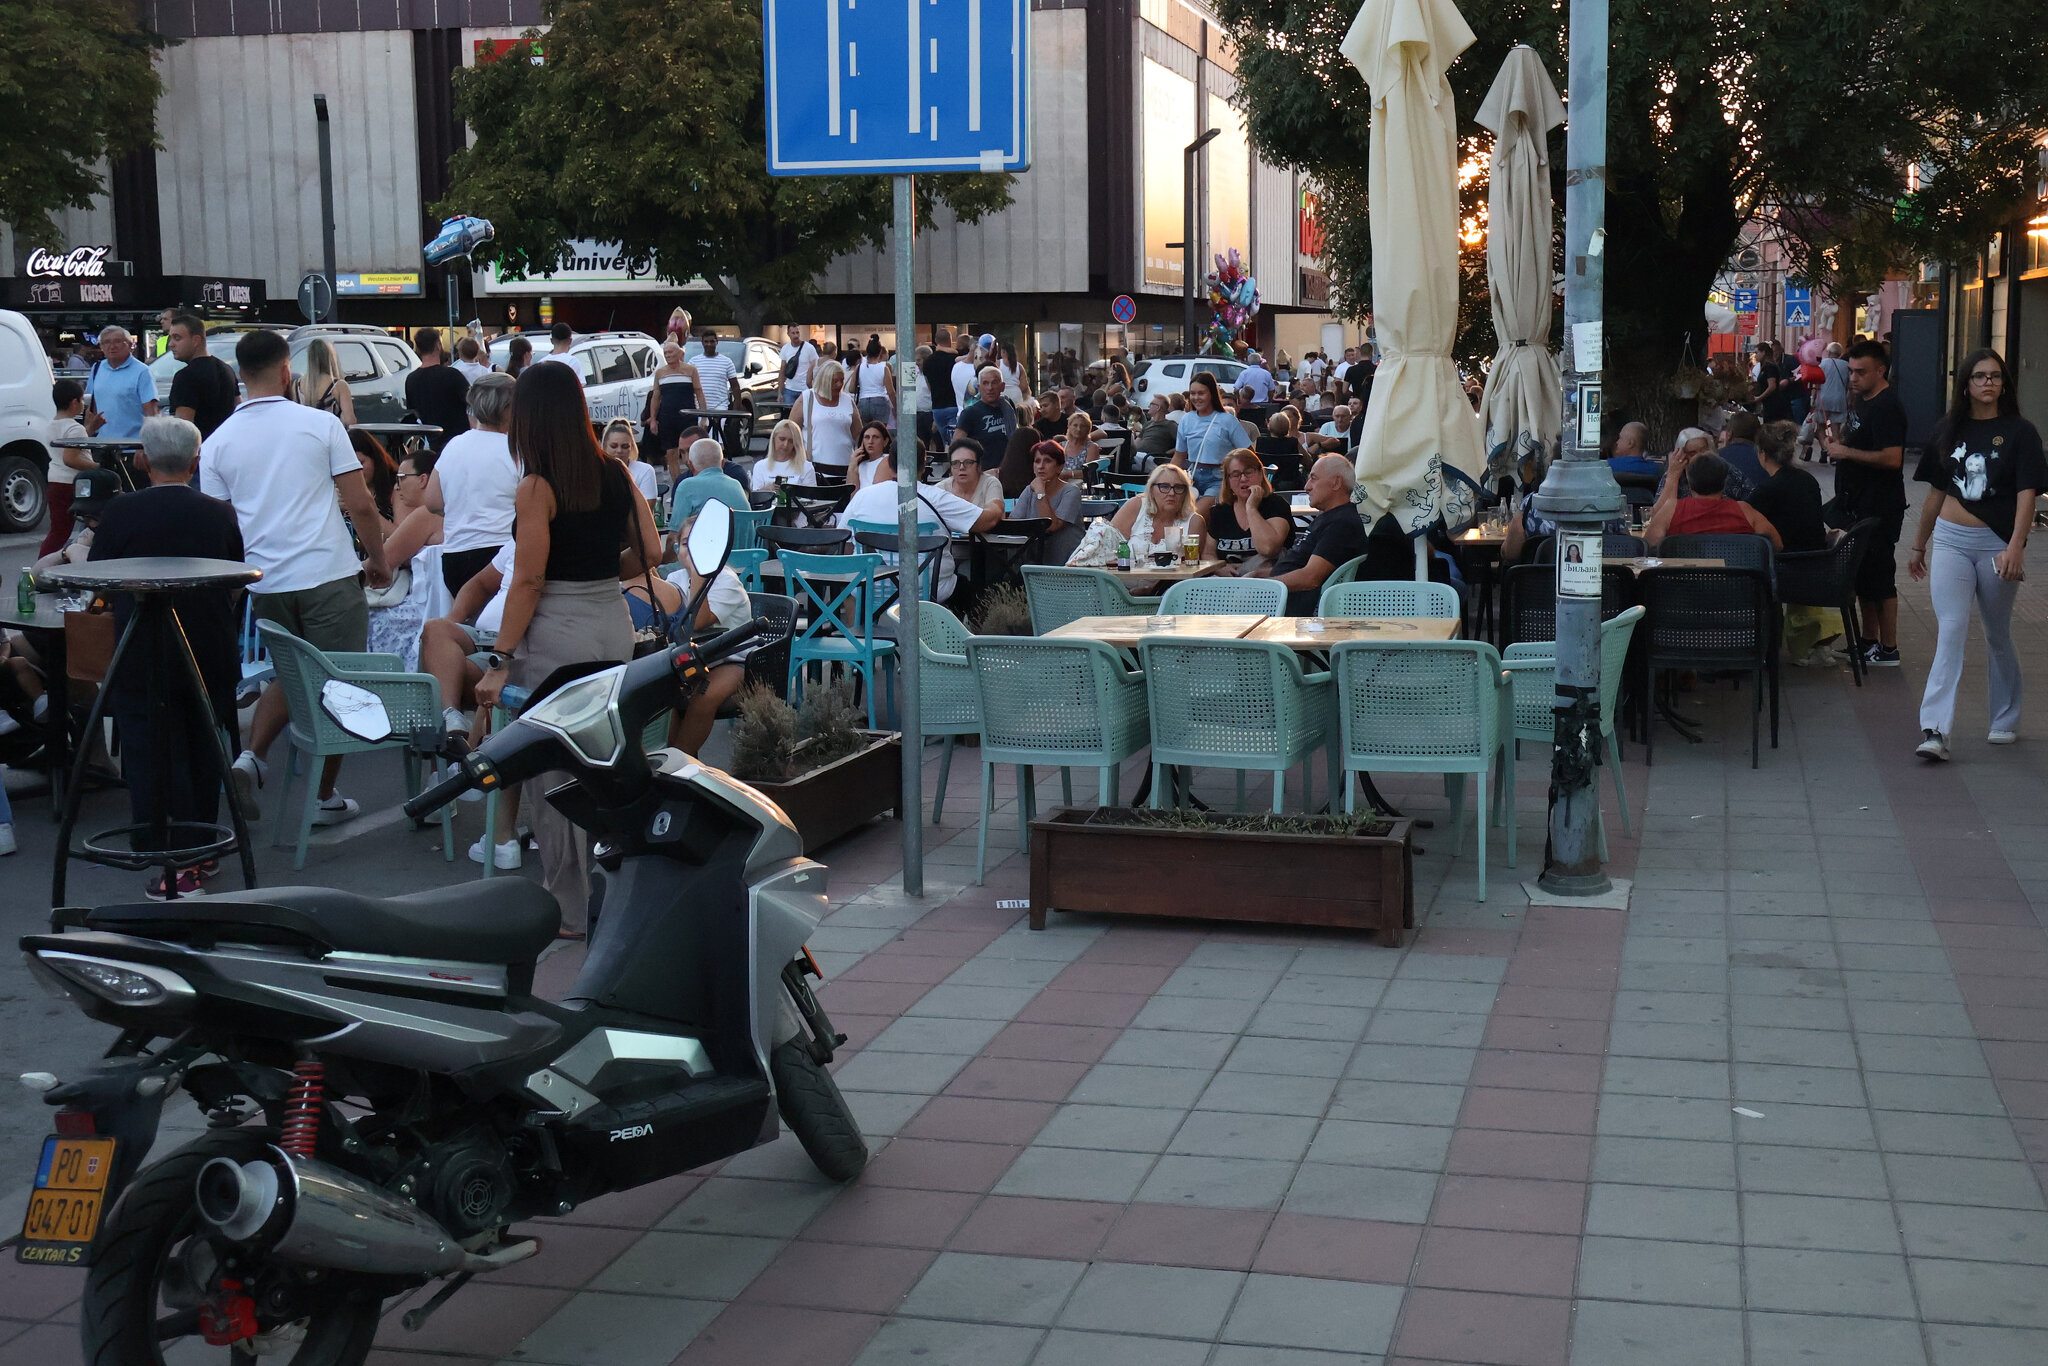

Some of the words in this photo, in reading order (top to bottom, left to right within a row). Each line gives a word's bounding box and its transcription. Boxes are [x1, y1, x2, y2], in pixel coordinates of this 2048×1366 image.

[80, 284, 113, 302] KIOSK
[229, 285, 250, 303] KIOSK
[1738, 291, 1752, 309] P
[594, 404, 619, 419] SYSTEM
[1564, 563, 1598, 573] Љиљана
[55, 1148, 83, 1183] PO
[22, 1246, 67, 1260] CENTAR
[67, 1247, 82, 1262] S
